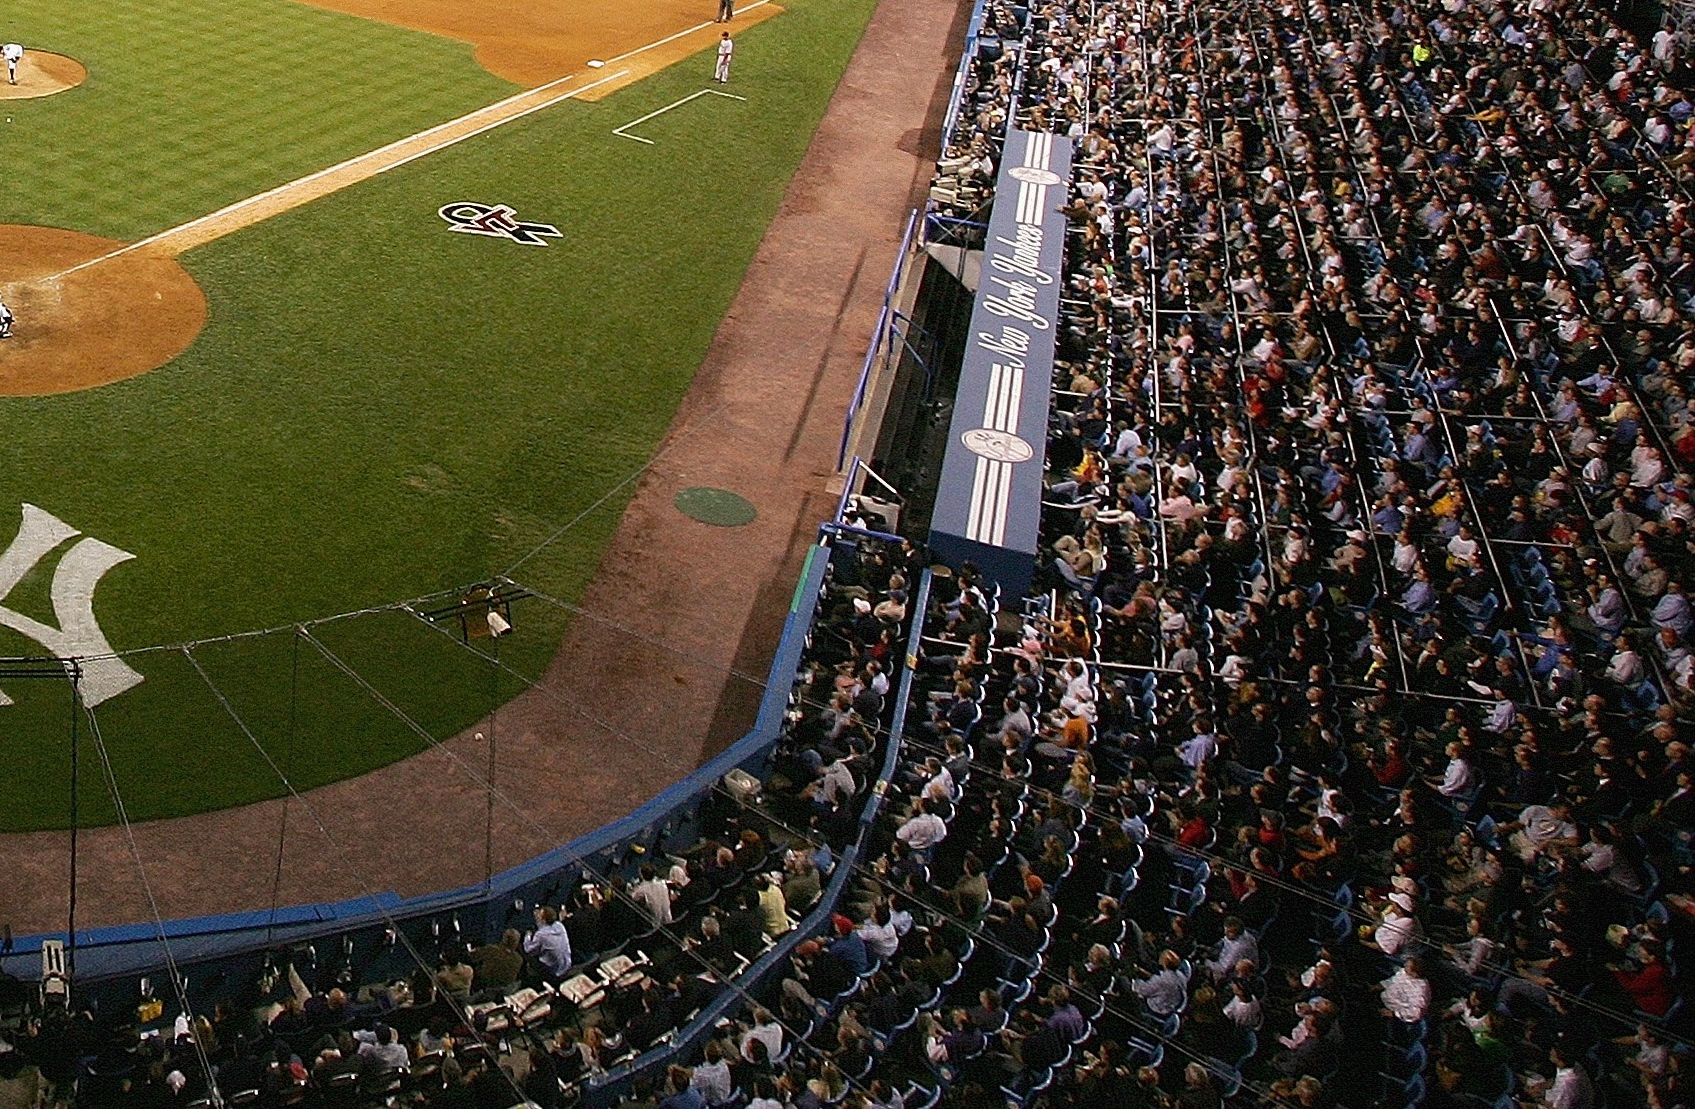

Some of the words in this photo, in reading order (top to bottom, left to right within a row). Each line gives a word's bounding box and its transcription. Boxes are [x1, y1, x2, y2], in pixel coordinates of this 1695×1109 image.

[990, 224, 1055, 285] Yankees
[982, 277, 1049, 329] York
[977, 326, 1031, 369] New
